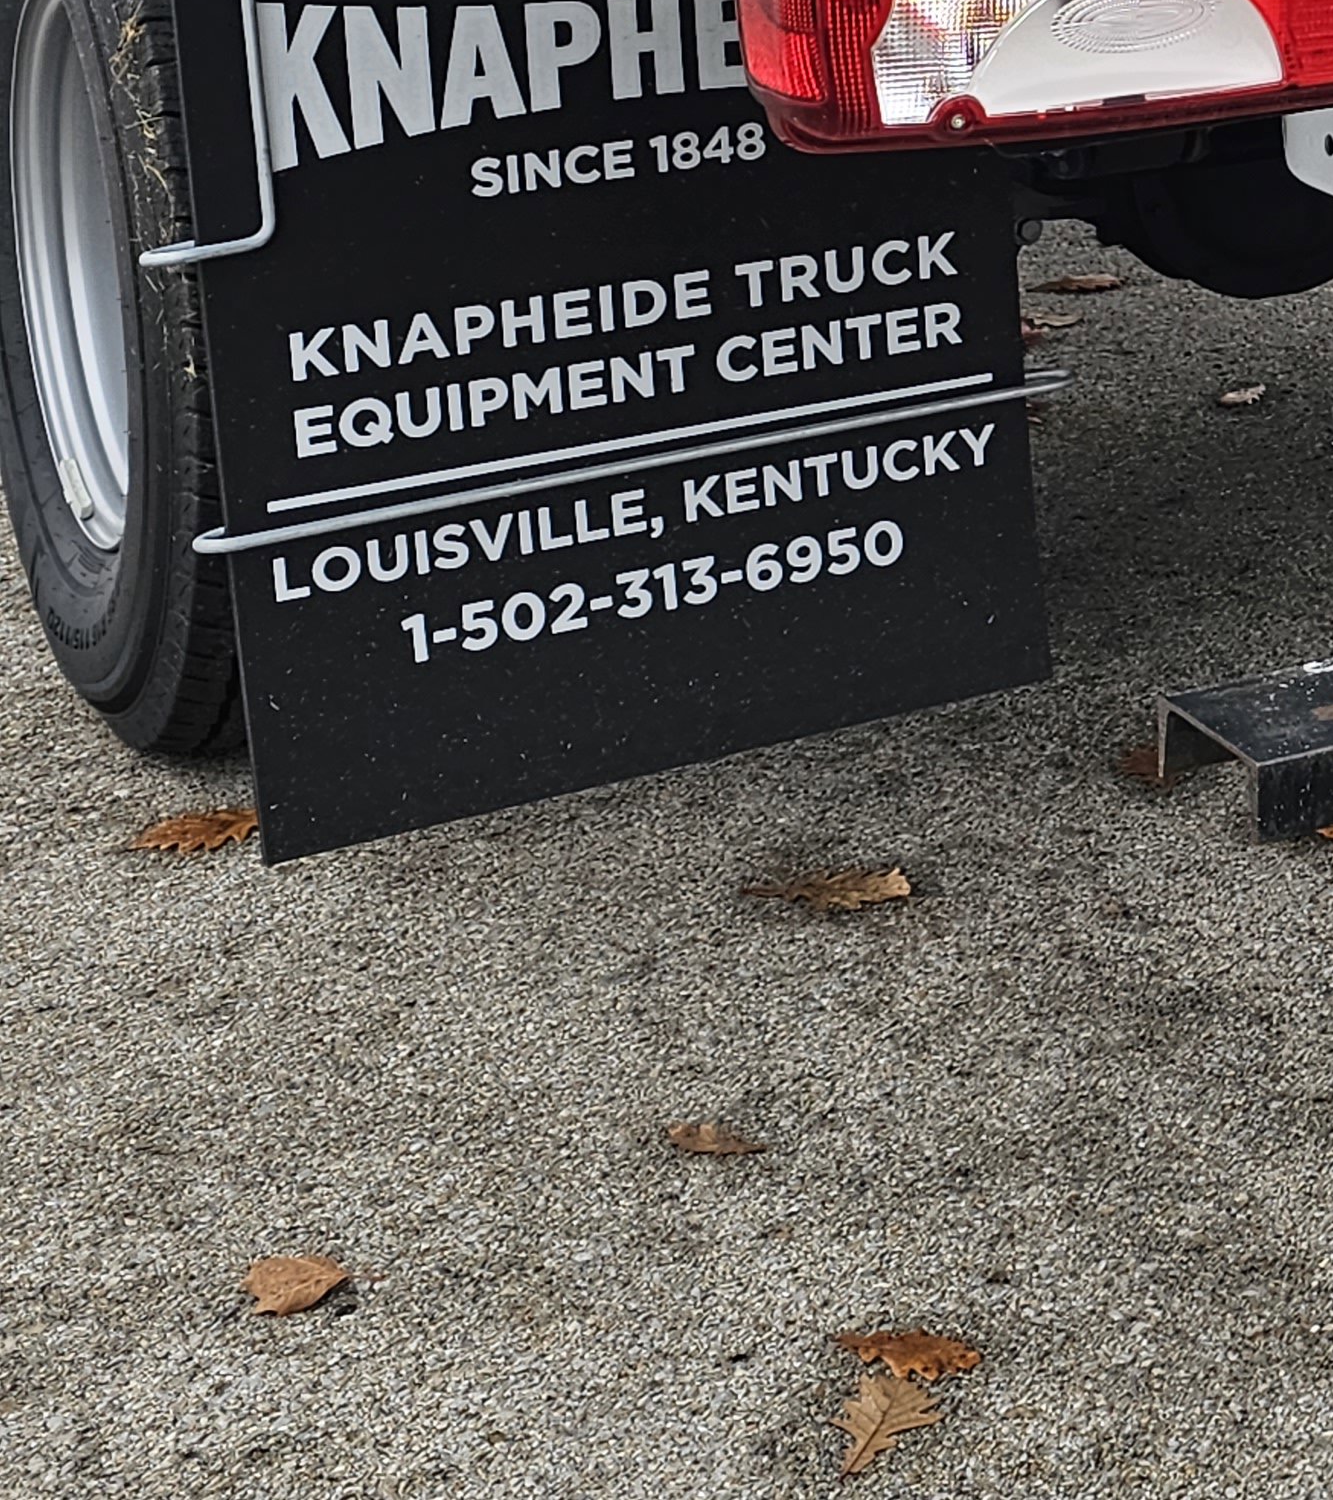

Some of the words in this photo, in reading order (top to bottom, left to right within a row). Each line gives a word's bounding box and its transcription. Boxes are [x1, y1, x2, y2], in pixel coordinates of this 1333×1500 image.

[471, 140, 634, 197] SINCE
[648, 122, 766, 174] 1848
[289, 269, 712, 383] KNAPHEIDE
[735, 231, 959, 309] TRUCK
[293, 344, 696, 460] EQUIPMENT
[716, 301, 963, 383] CENTER
[271, 488, 664, 603] LOUISVILLE,
[683, 424, 997, 523] KENTUCKY
[400, 519, 905, 664] 1-502-313-6950
